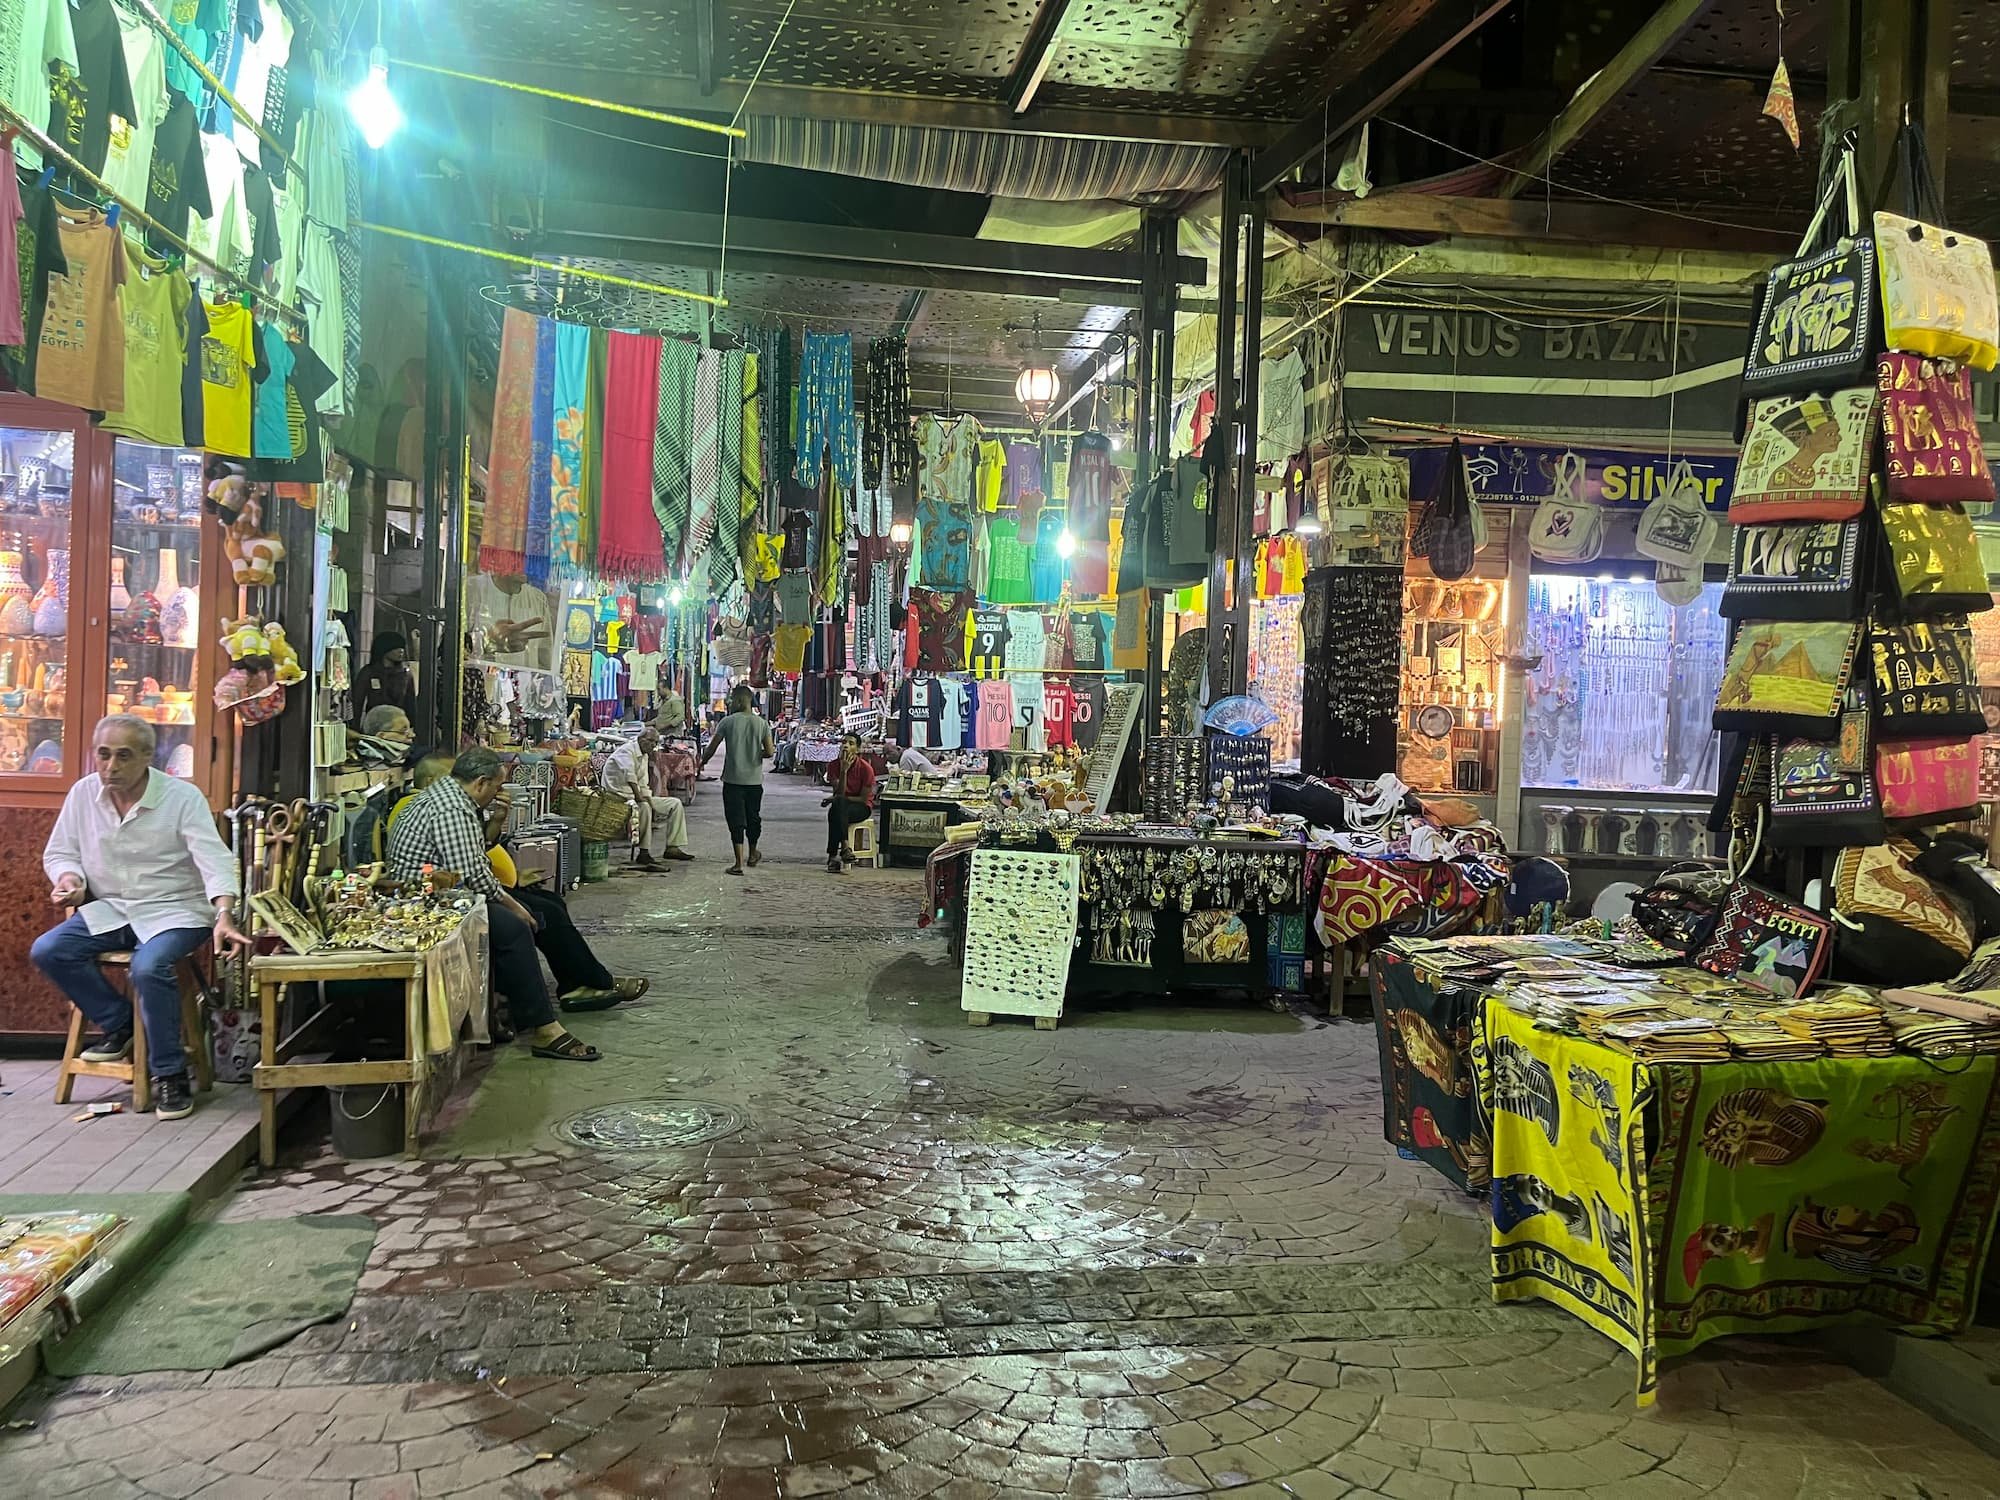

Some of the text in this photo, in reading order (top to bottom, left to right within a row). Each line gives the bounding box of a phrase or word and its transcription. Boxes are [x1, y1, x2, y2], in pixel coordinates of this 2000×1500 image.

[1788, 258, 1849, 289] EGYPT
[41, 336, 79, 351] EGYPT
[1372, 313, 1698, 362] VENUS BAZAR
[1601, 465, 1724, 503] Silver
[982, 633, 995, 654] 9
[908, 707, 930, 717] QATAR
[986, 702, 1007, 722] 10
[1045, 697, 1064, 722] 10
